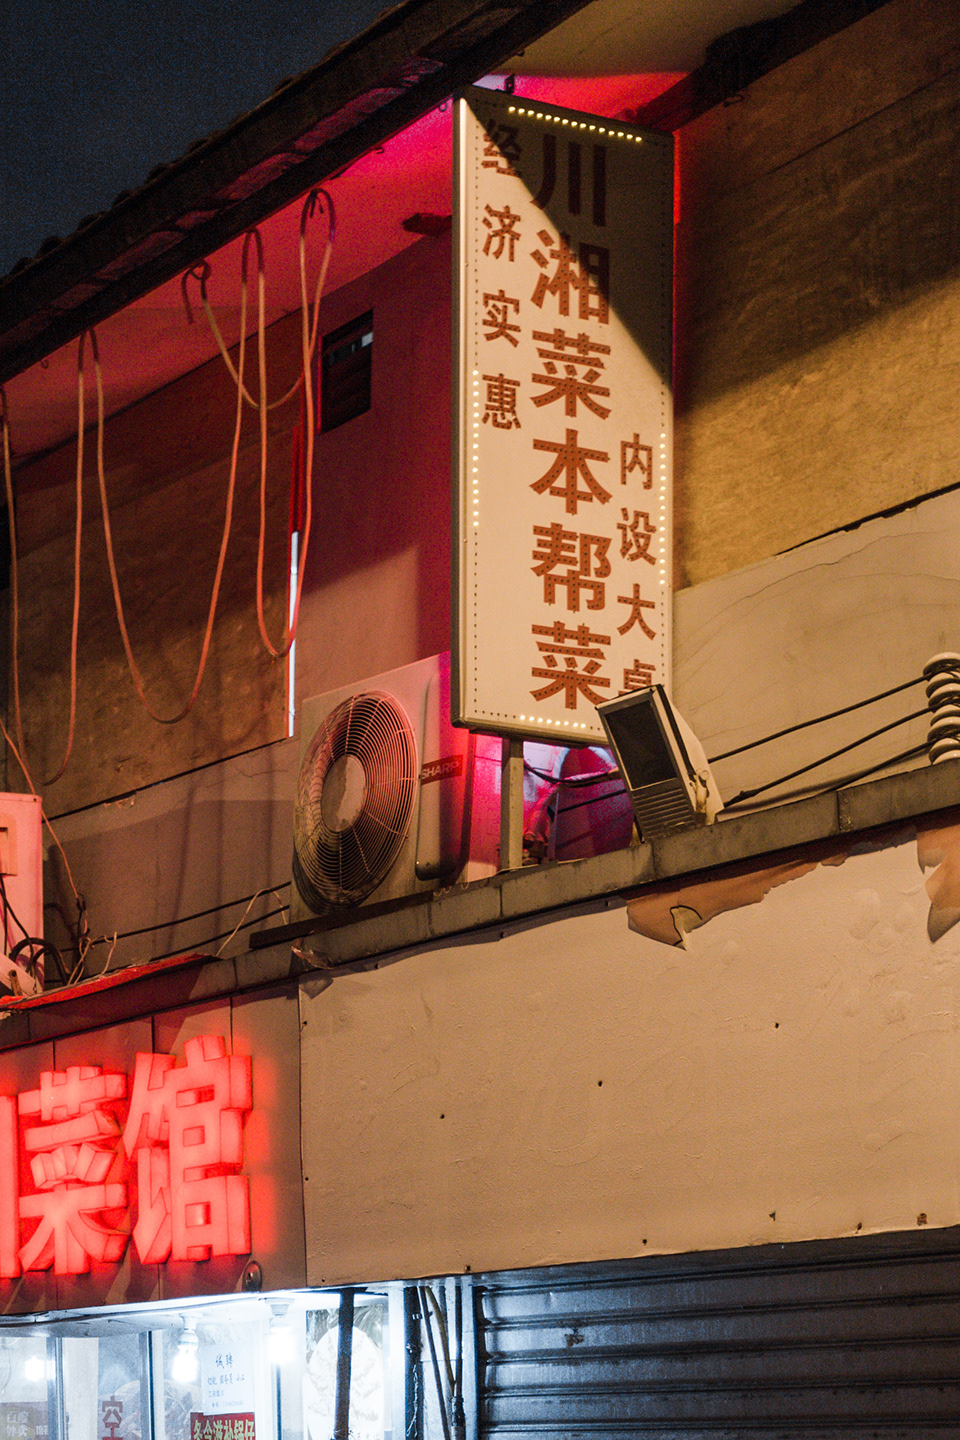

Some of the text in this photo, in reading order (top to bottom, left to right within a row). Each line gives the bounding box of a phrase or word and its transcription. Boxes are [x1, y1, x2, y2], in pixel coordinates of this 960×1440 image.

[481, 118, 522, 430] 经济实惠
[529, 133, 613, 710] 川湘菜本帮菜
[421, 761, 460, 779] SHARP
